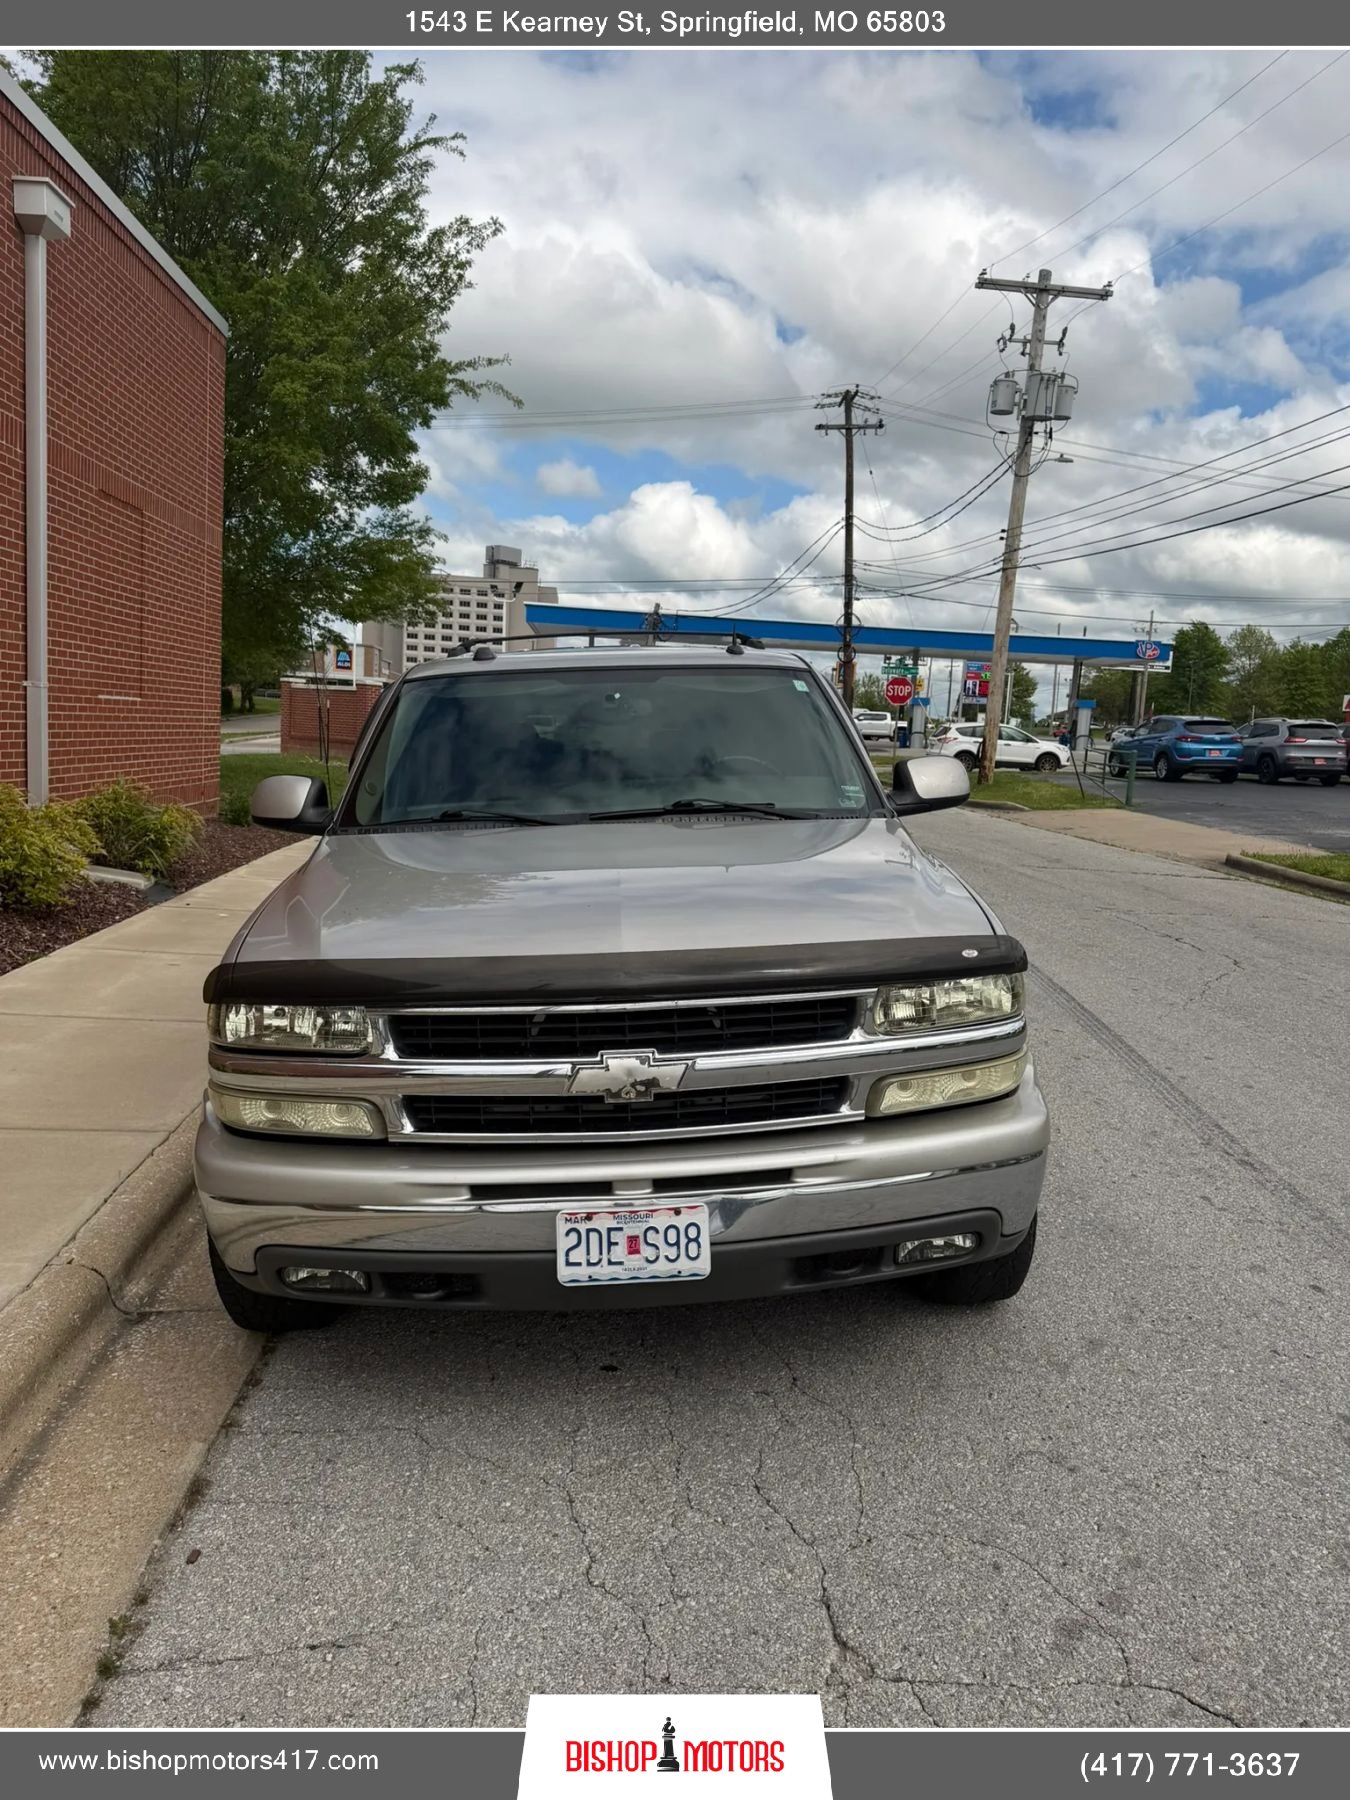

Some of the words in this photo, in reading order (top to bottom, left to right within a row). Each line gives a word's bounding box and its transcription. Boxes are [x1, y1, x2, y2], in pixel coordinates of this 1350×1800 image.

[887, 685, 911, 697] STOP
[564, 1215, 587, 1225] MAR
[612, 1213, 654, 1221] MISSOURI
[564, 1226, 625, 1267] 2DE
[643, 1221, 702, 1265] S98
[628, 1239, 638, 1249] 27
